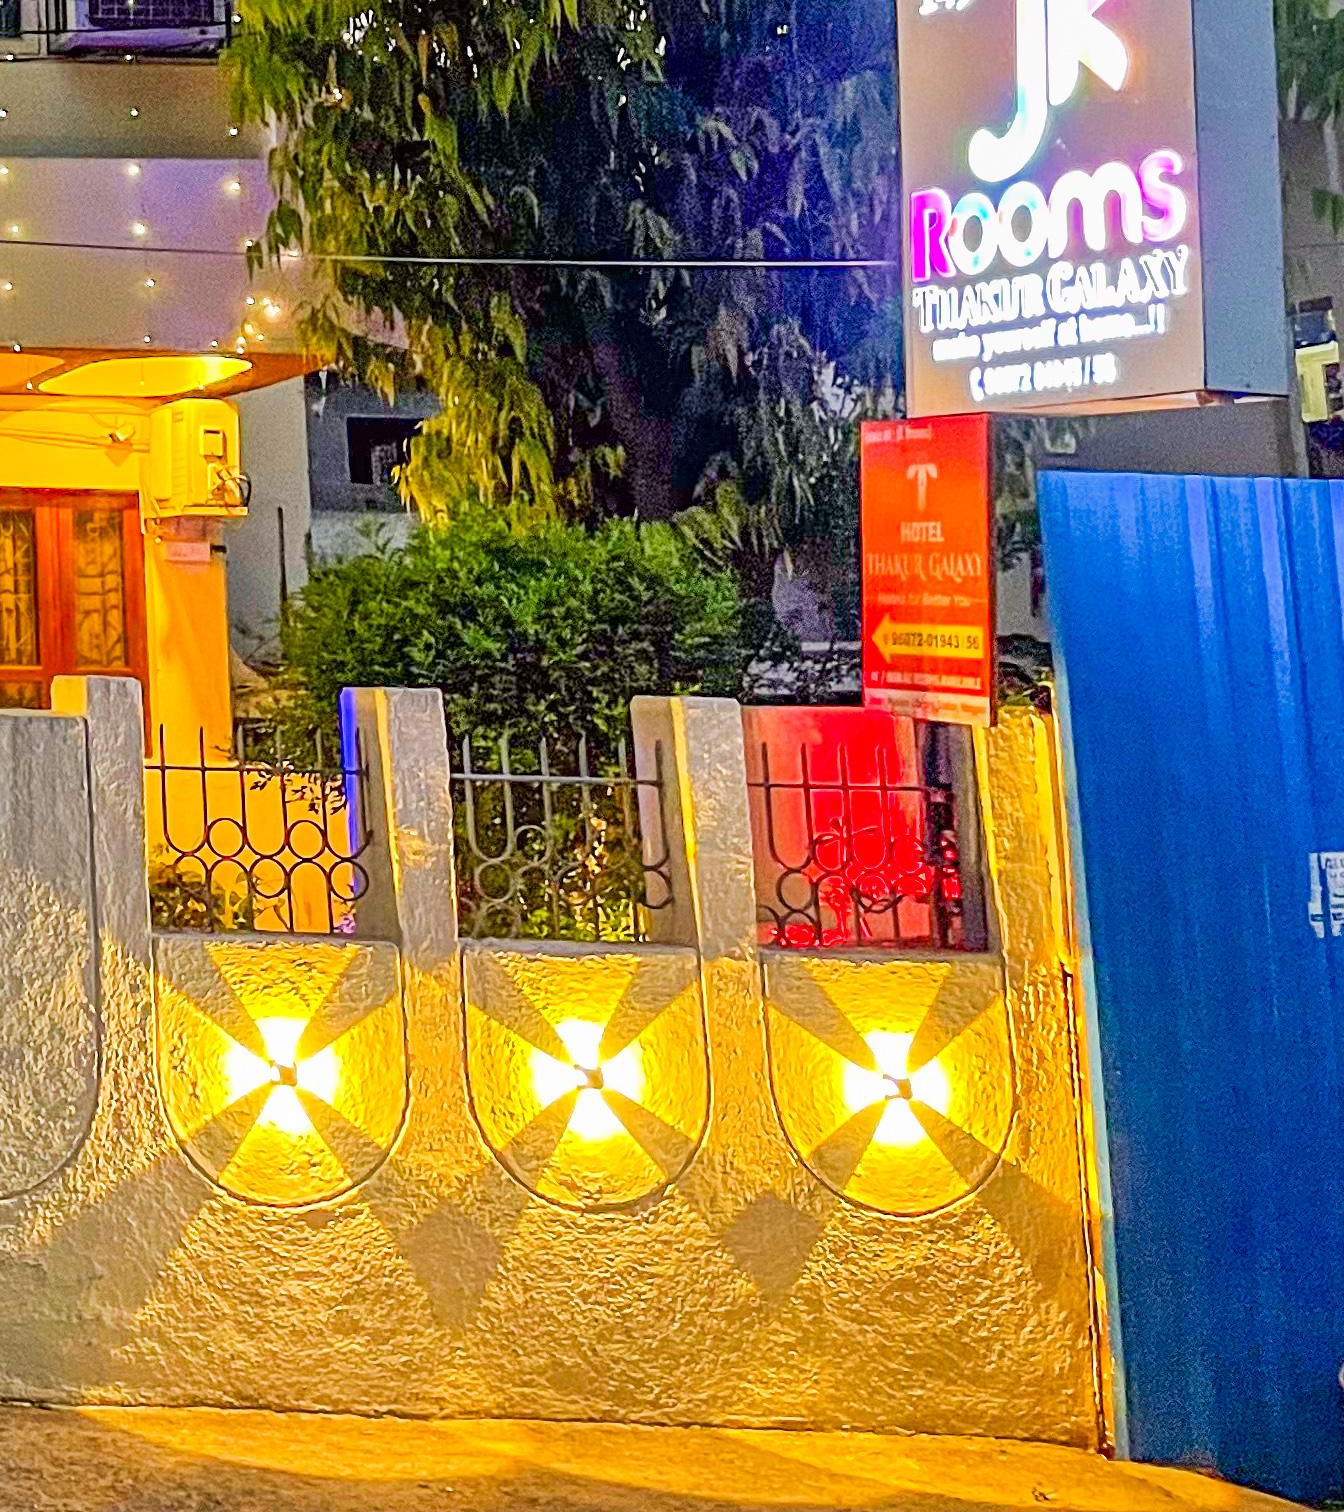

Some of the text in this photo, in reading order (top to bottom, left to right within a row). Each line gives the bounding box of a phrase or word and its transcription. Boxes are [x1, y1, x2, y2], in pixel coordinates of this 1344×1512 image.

[900, 521, 944, 543] HOTEL
[867, 552, 981, 583] THAKUR GALAXY
